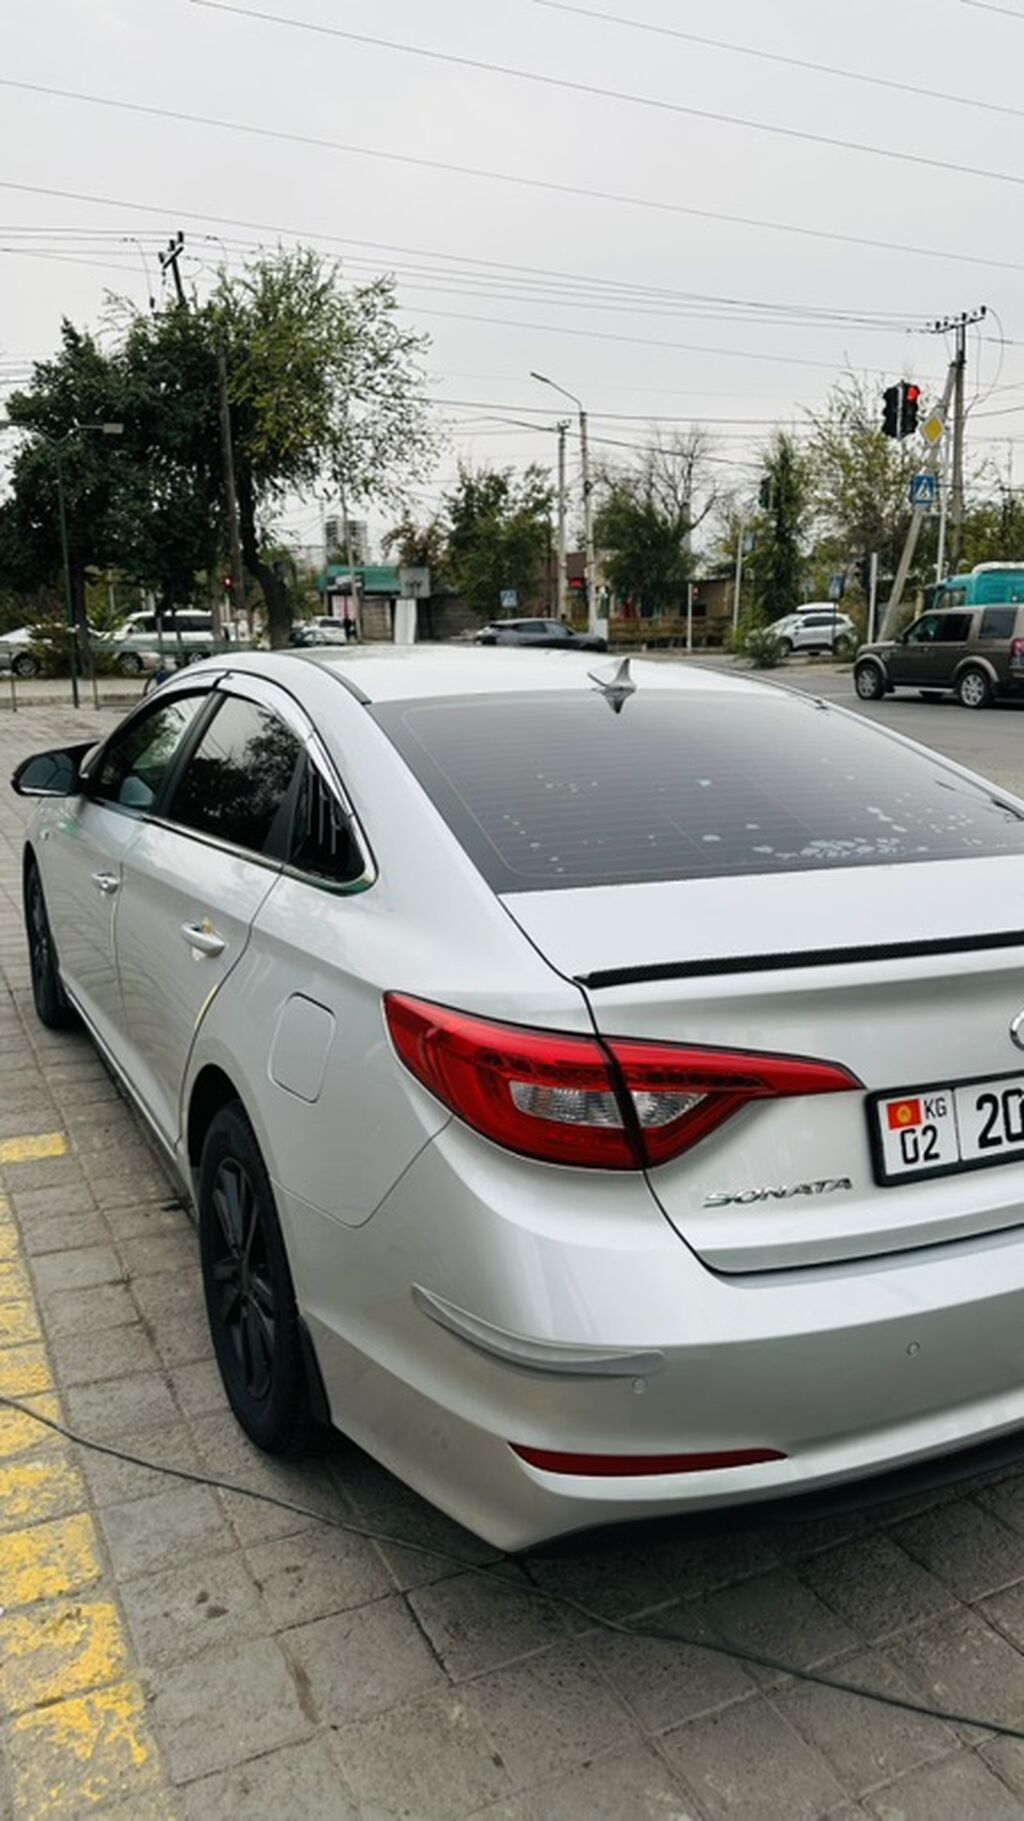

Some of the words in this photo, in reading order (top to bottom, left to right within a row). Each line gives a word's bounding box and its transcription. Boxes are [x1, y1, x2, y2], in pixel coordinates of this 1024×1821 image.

[924, 1098, 947, 1119] KG
[901, 1124, 940, 1164] 02
[703, 1178, 852, 1207] SONATA
